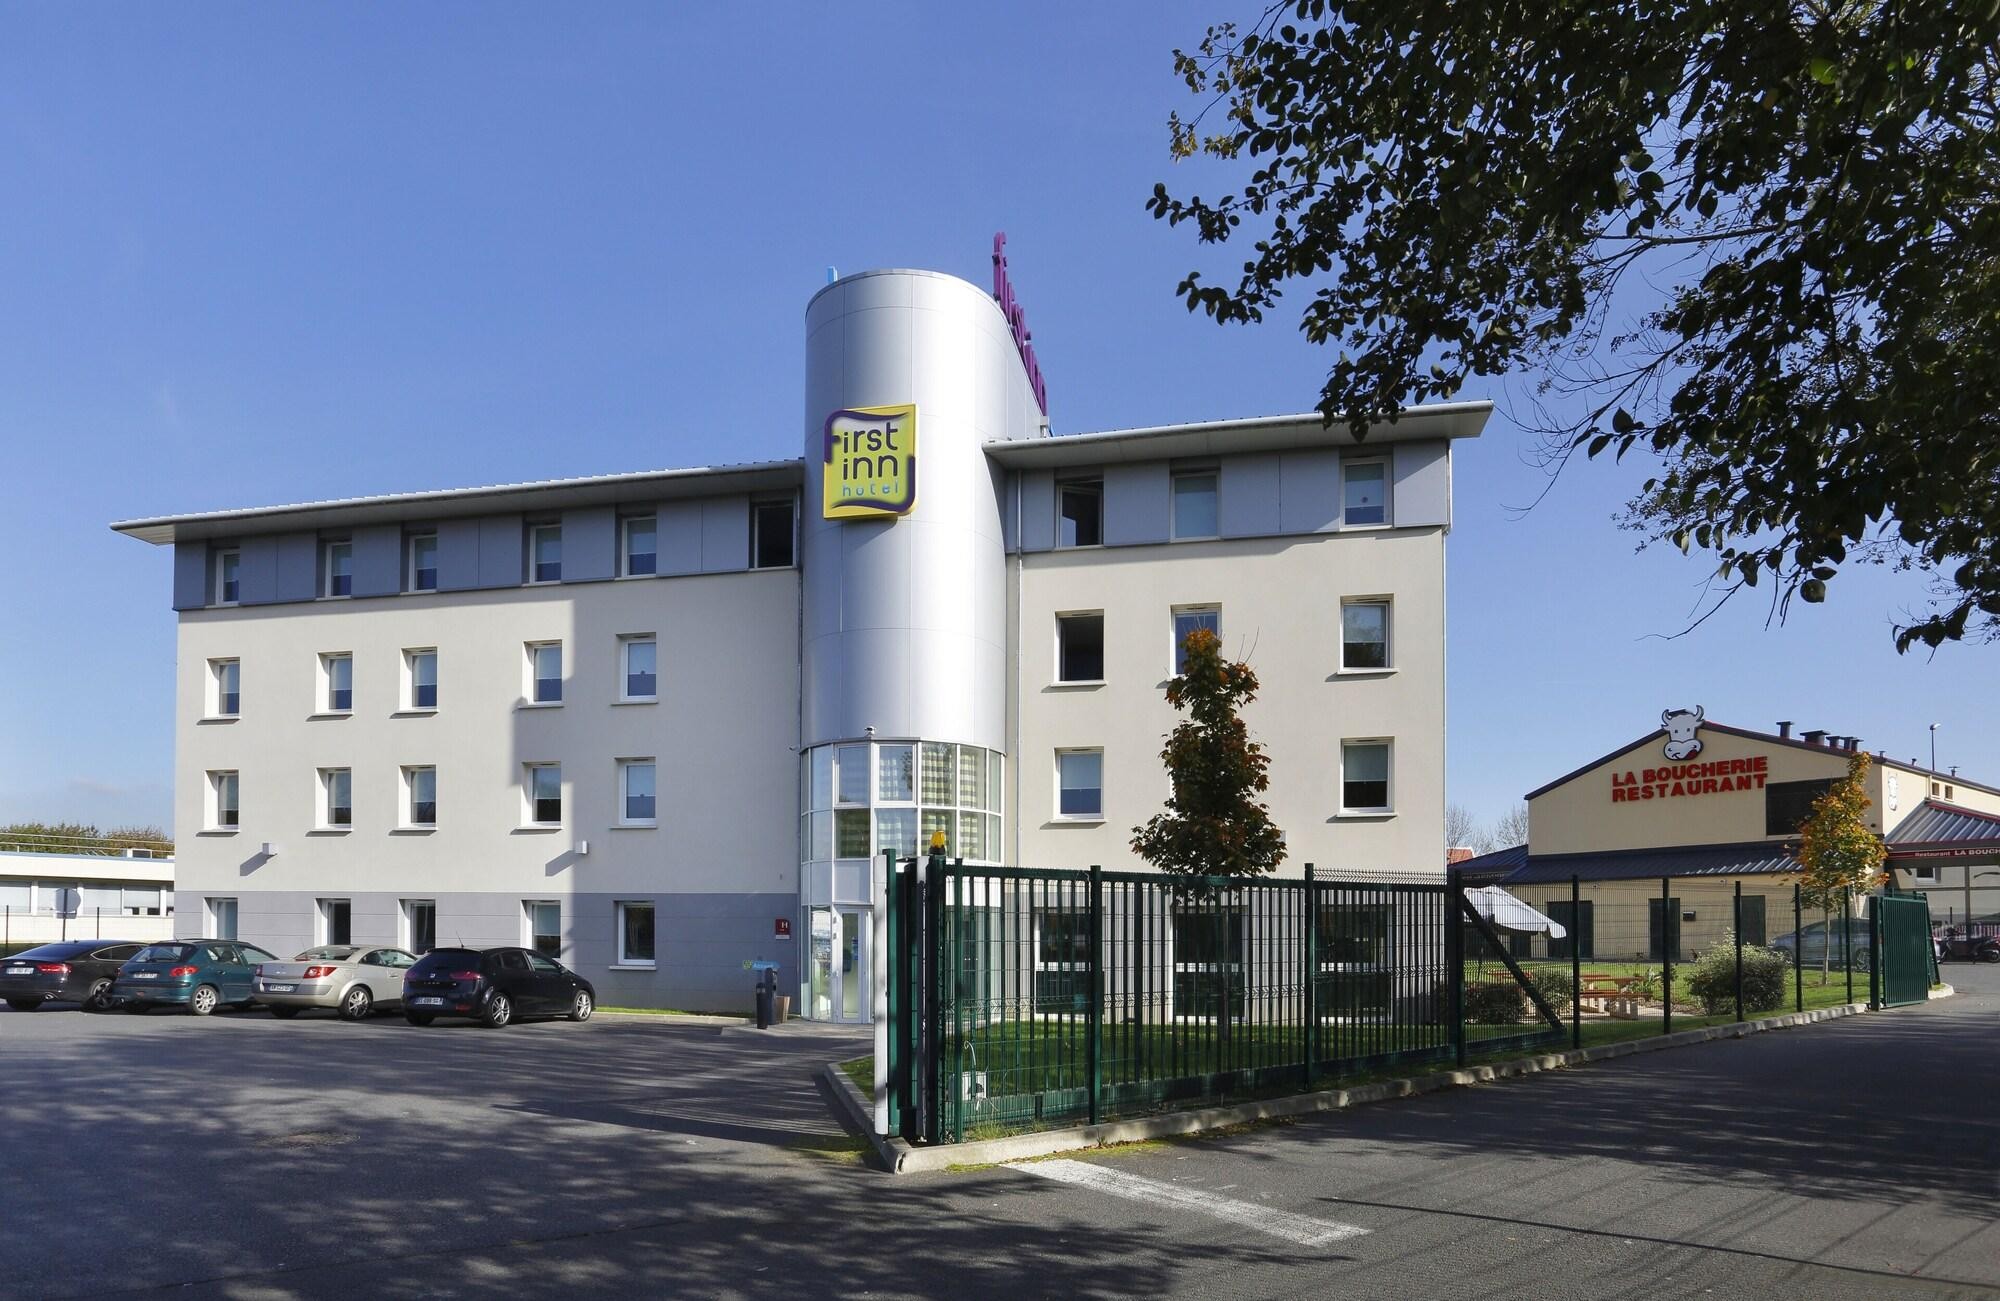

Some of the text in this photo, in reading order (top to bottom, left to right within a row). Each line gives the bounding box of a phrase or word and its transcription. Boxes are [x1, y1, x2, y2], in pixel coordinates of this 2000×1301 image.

[843, 455, 898, 480] inn
[842, 482, 898, 497] hotel
[1612, 756, 1768, 787] LA BOUCHERIE
[1612, 773, 1768, 802] RESTAURANT
